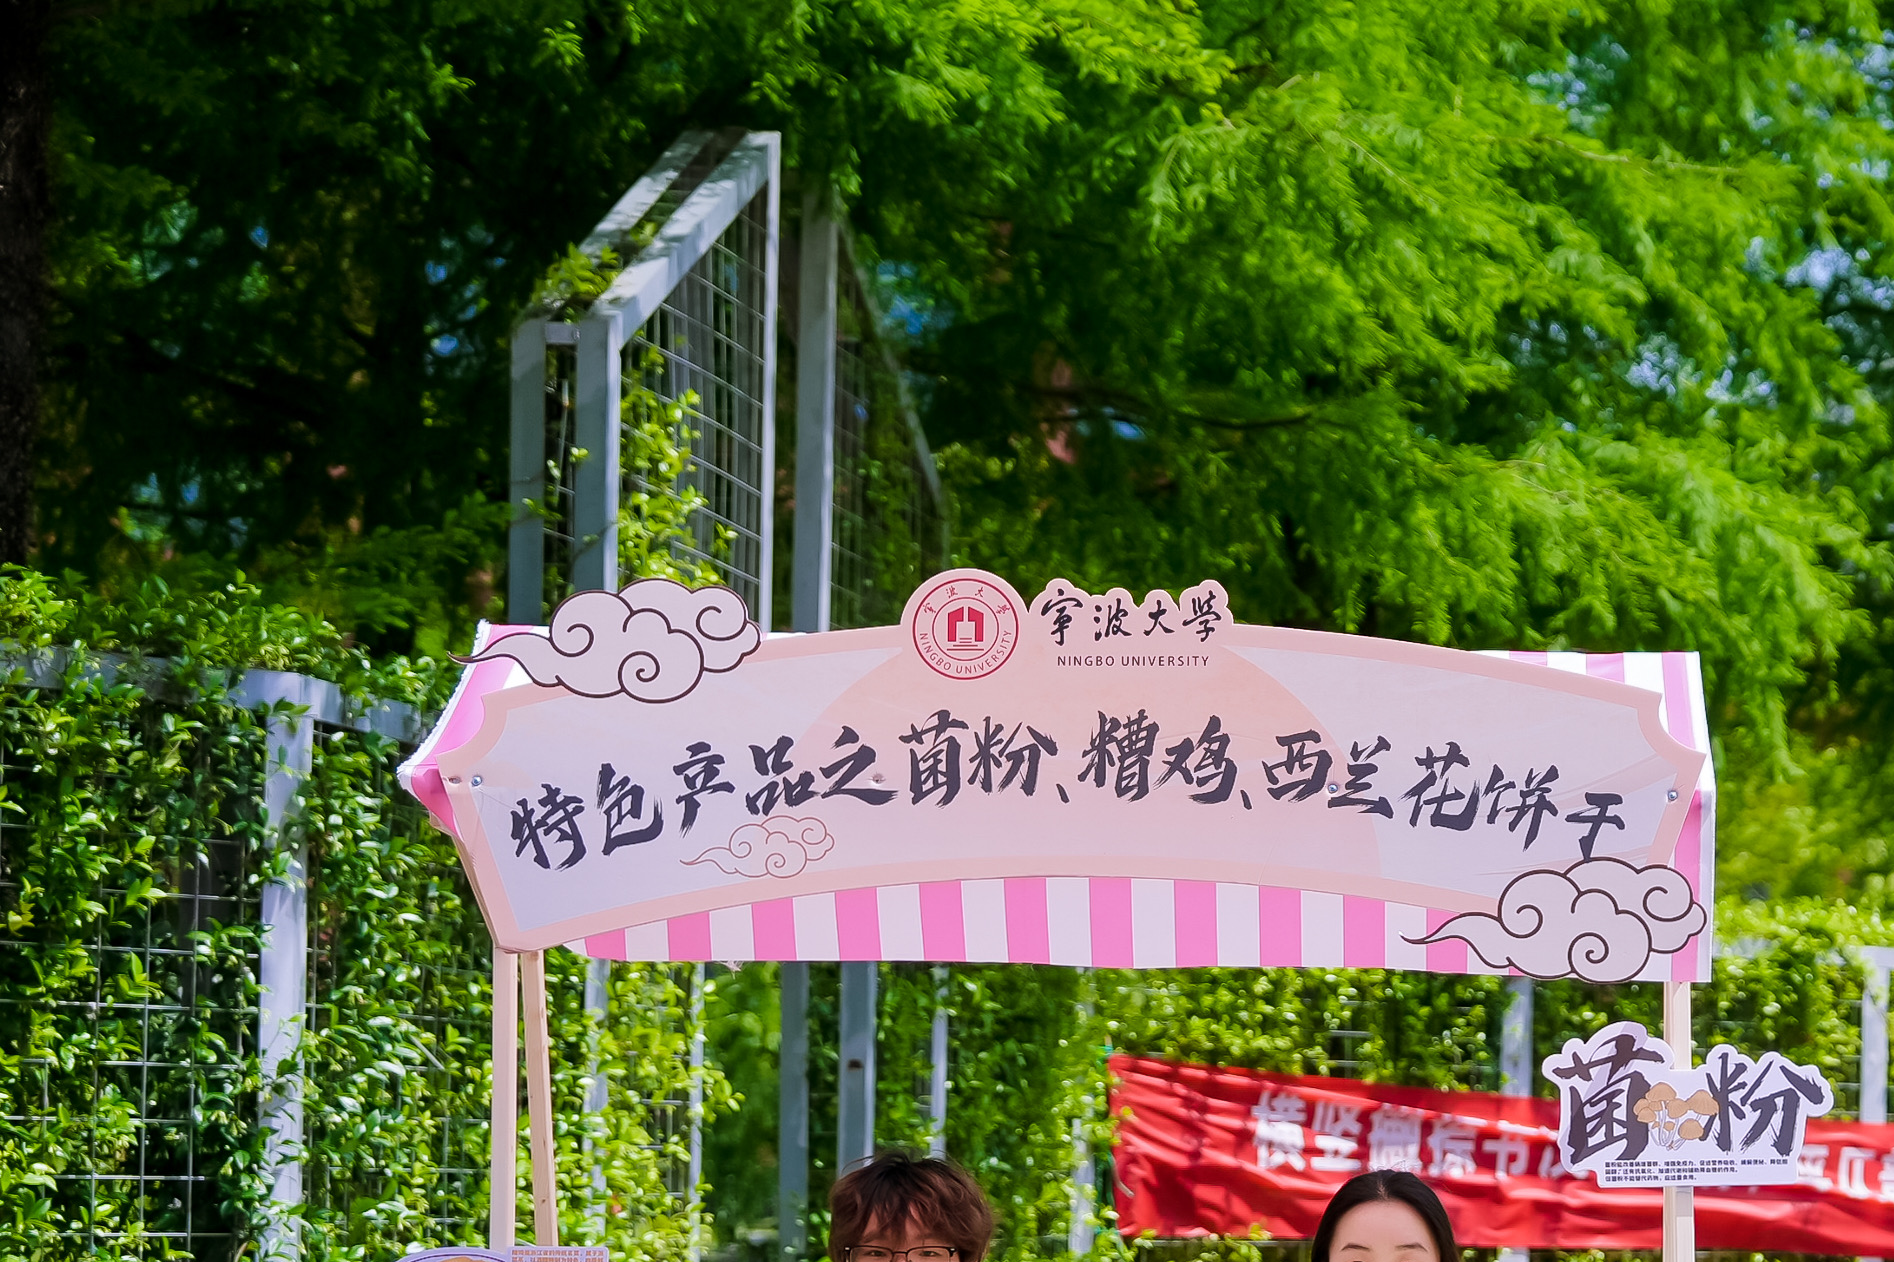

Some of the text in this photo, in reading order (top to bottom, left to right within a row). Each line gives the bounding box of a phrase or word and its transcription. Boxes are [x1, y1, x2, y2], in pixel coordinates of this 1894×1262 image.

[919, 629, 1012, 676] NINGBO UNIVERSITY
[1057, 655, 1210, 667] NINGBO UNIVERSITY
[510, 708, 1627, 870] 特色产品之菌粉、糟鸡、西兰花饼干
[1552, 1033, 1826, 1164] 菌粉
